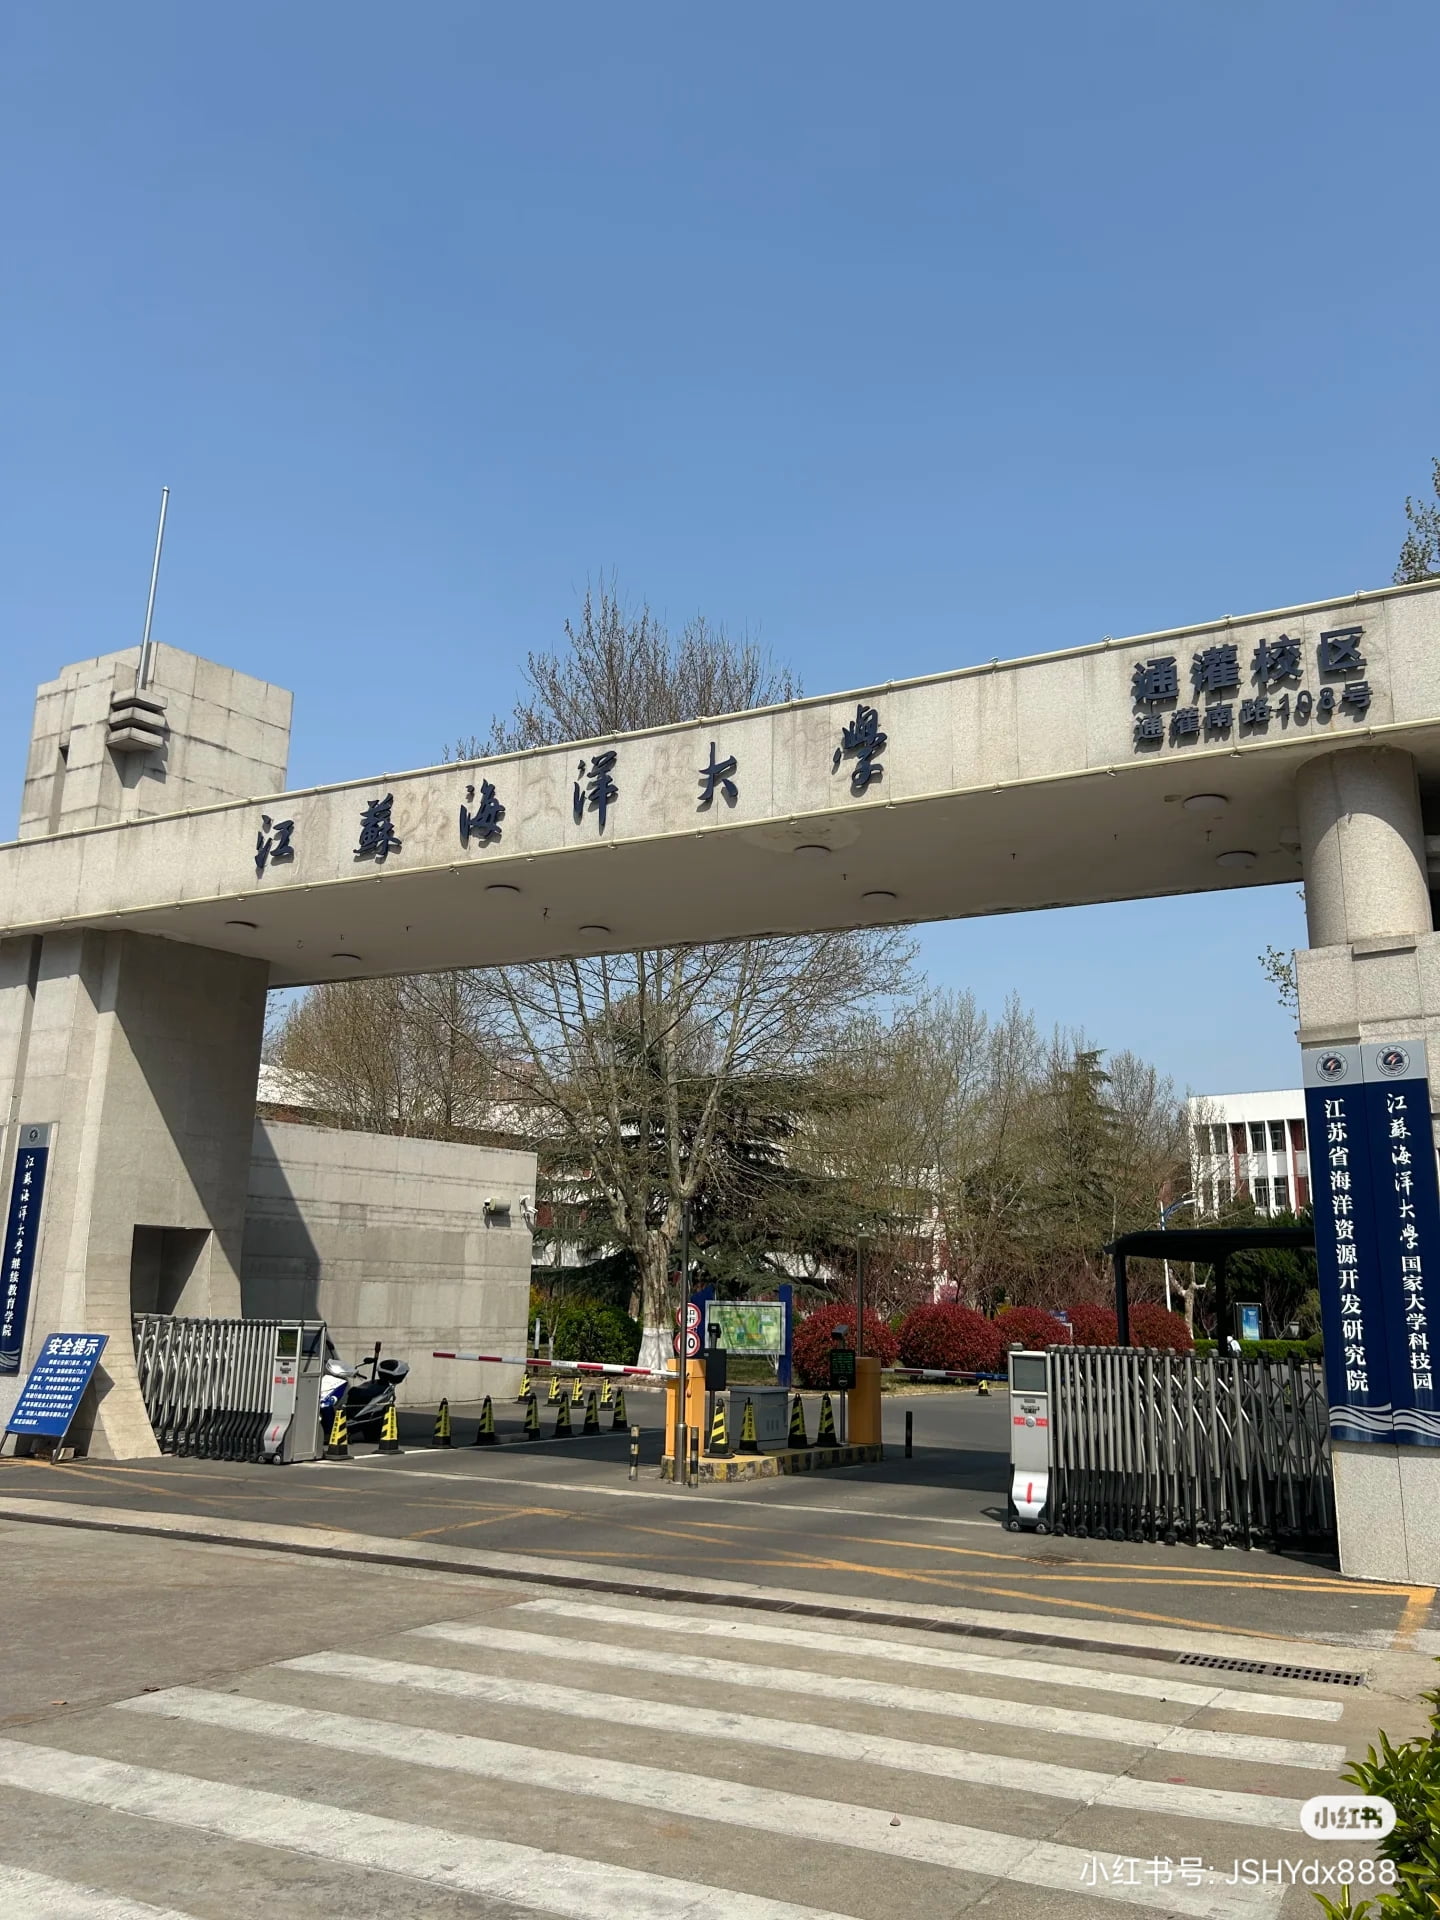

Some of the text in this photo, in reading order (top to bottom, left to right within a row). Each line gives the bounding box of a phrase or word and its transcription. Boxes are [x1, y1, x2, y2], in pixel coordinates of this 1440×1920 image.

[1133, 626, 1367, 702] 通灌校区
[1324, 1098, 1369, 1392] 江苏省海洋资源开发研究院
[46, 1337, 99, 1356] 安全提示
